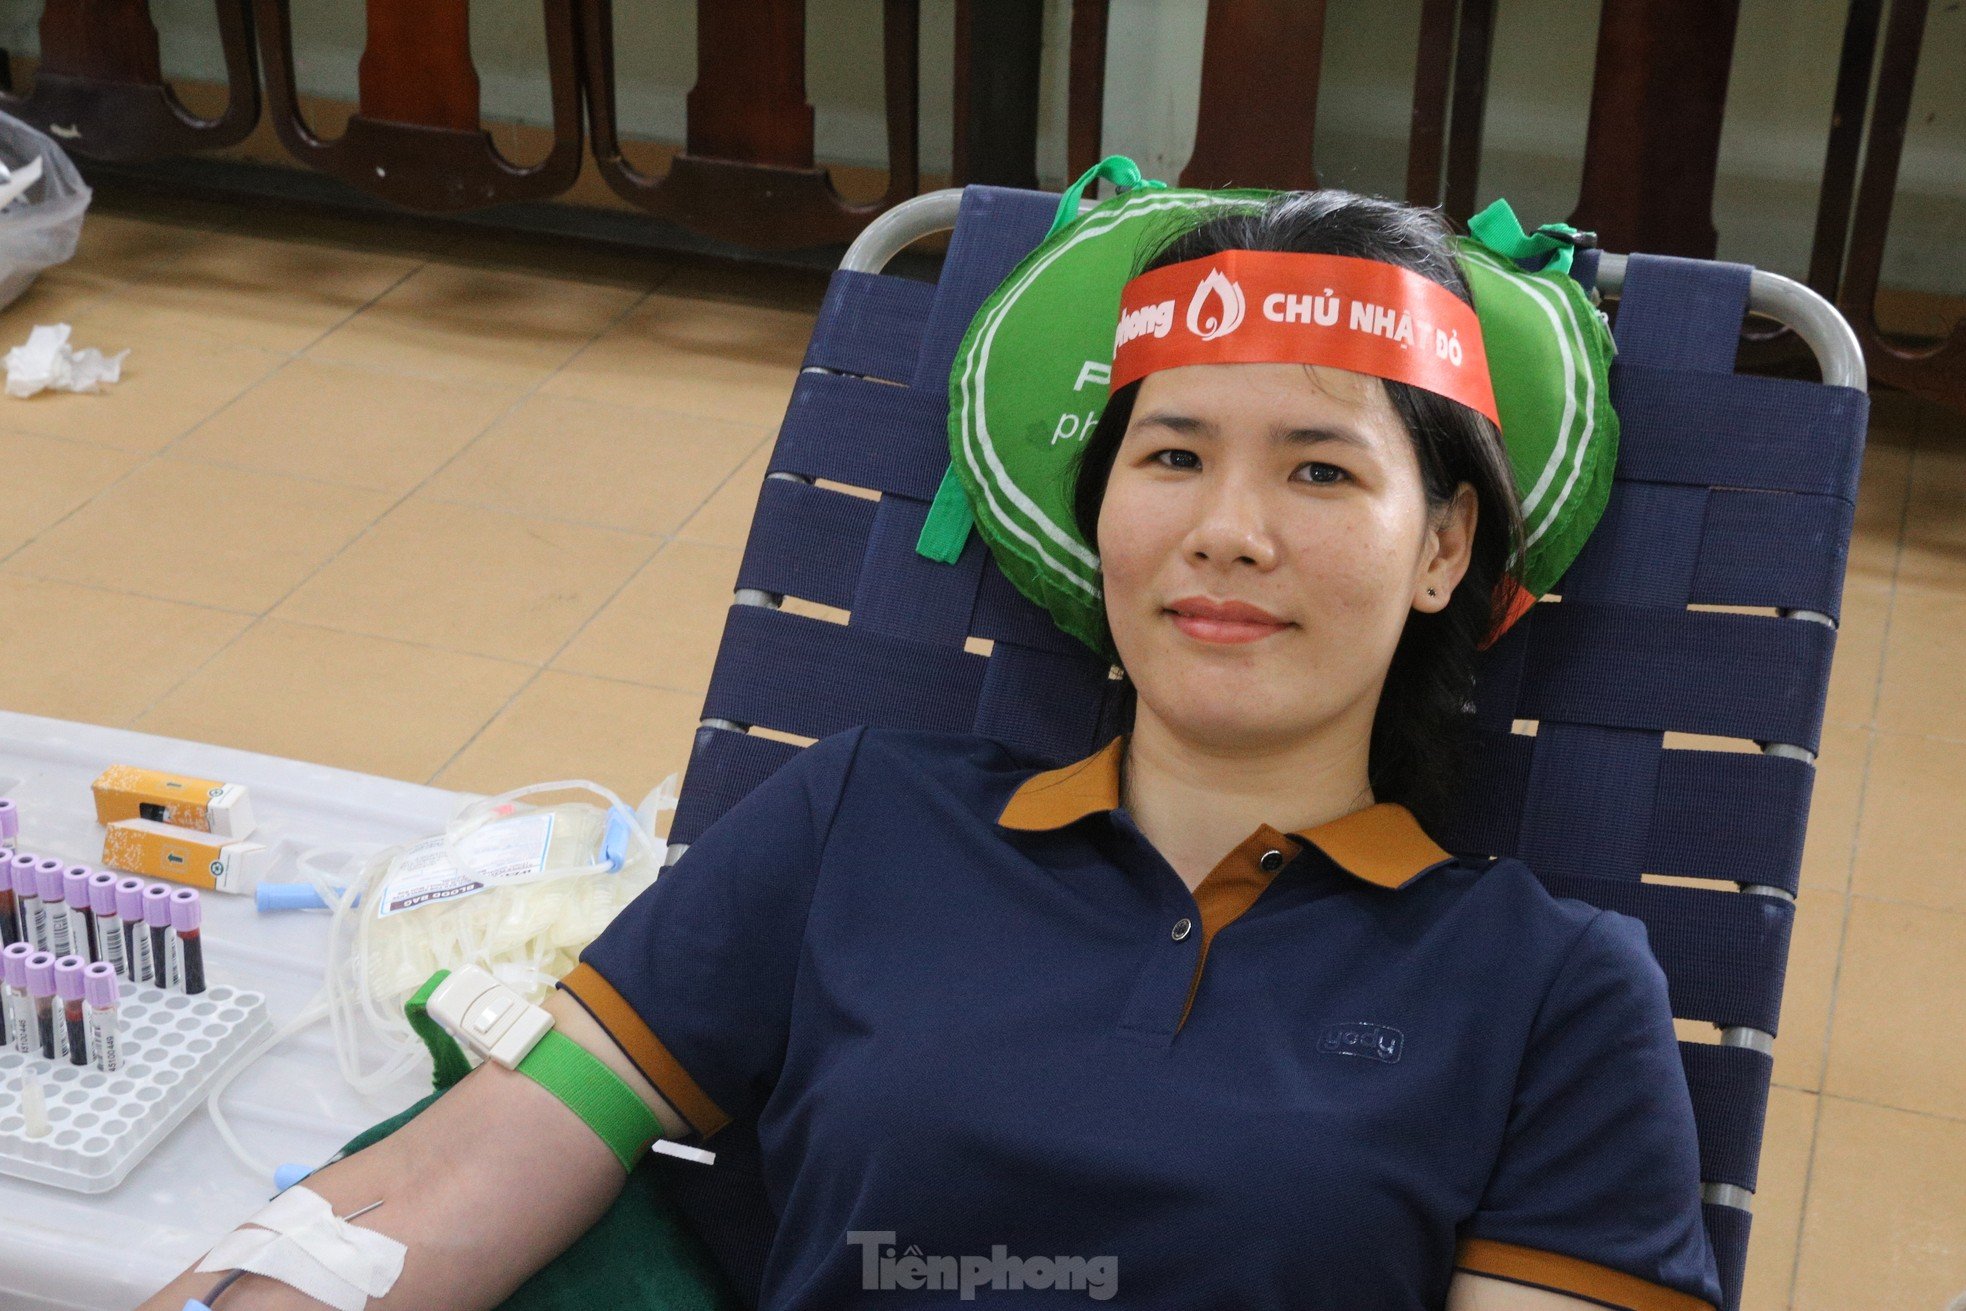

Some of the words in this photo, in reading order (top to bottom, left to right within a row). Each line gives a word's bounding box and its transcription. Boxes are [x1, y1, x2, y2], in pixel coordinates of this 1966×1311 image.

[1262, 288, 1340, 327] CHỦ
[1350, 300, 1432, 350] NHẬT
[1435, 328, 1463, 368] ĐỎ
[432, 883, 475, 899] BLOOD
[403, 894, 429, 908] BAG
